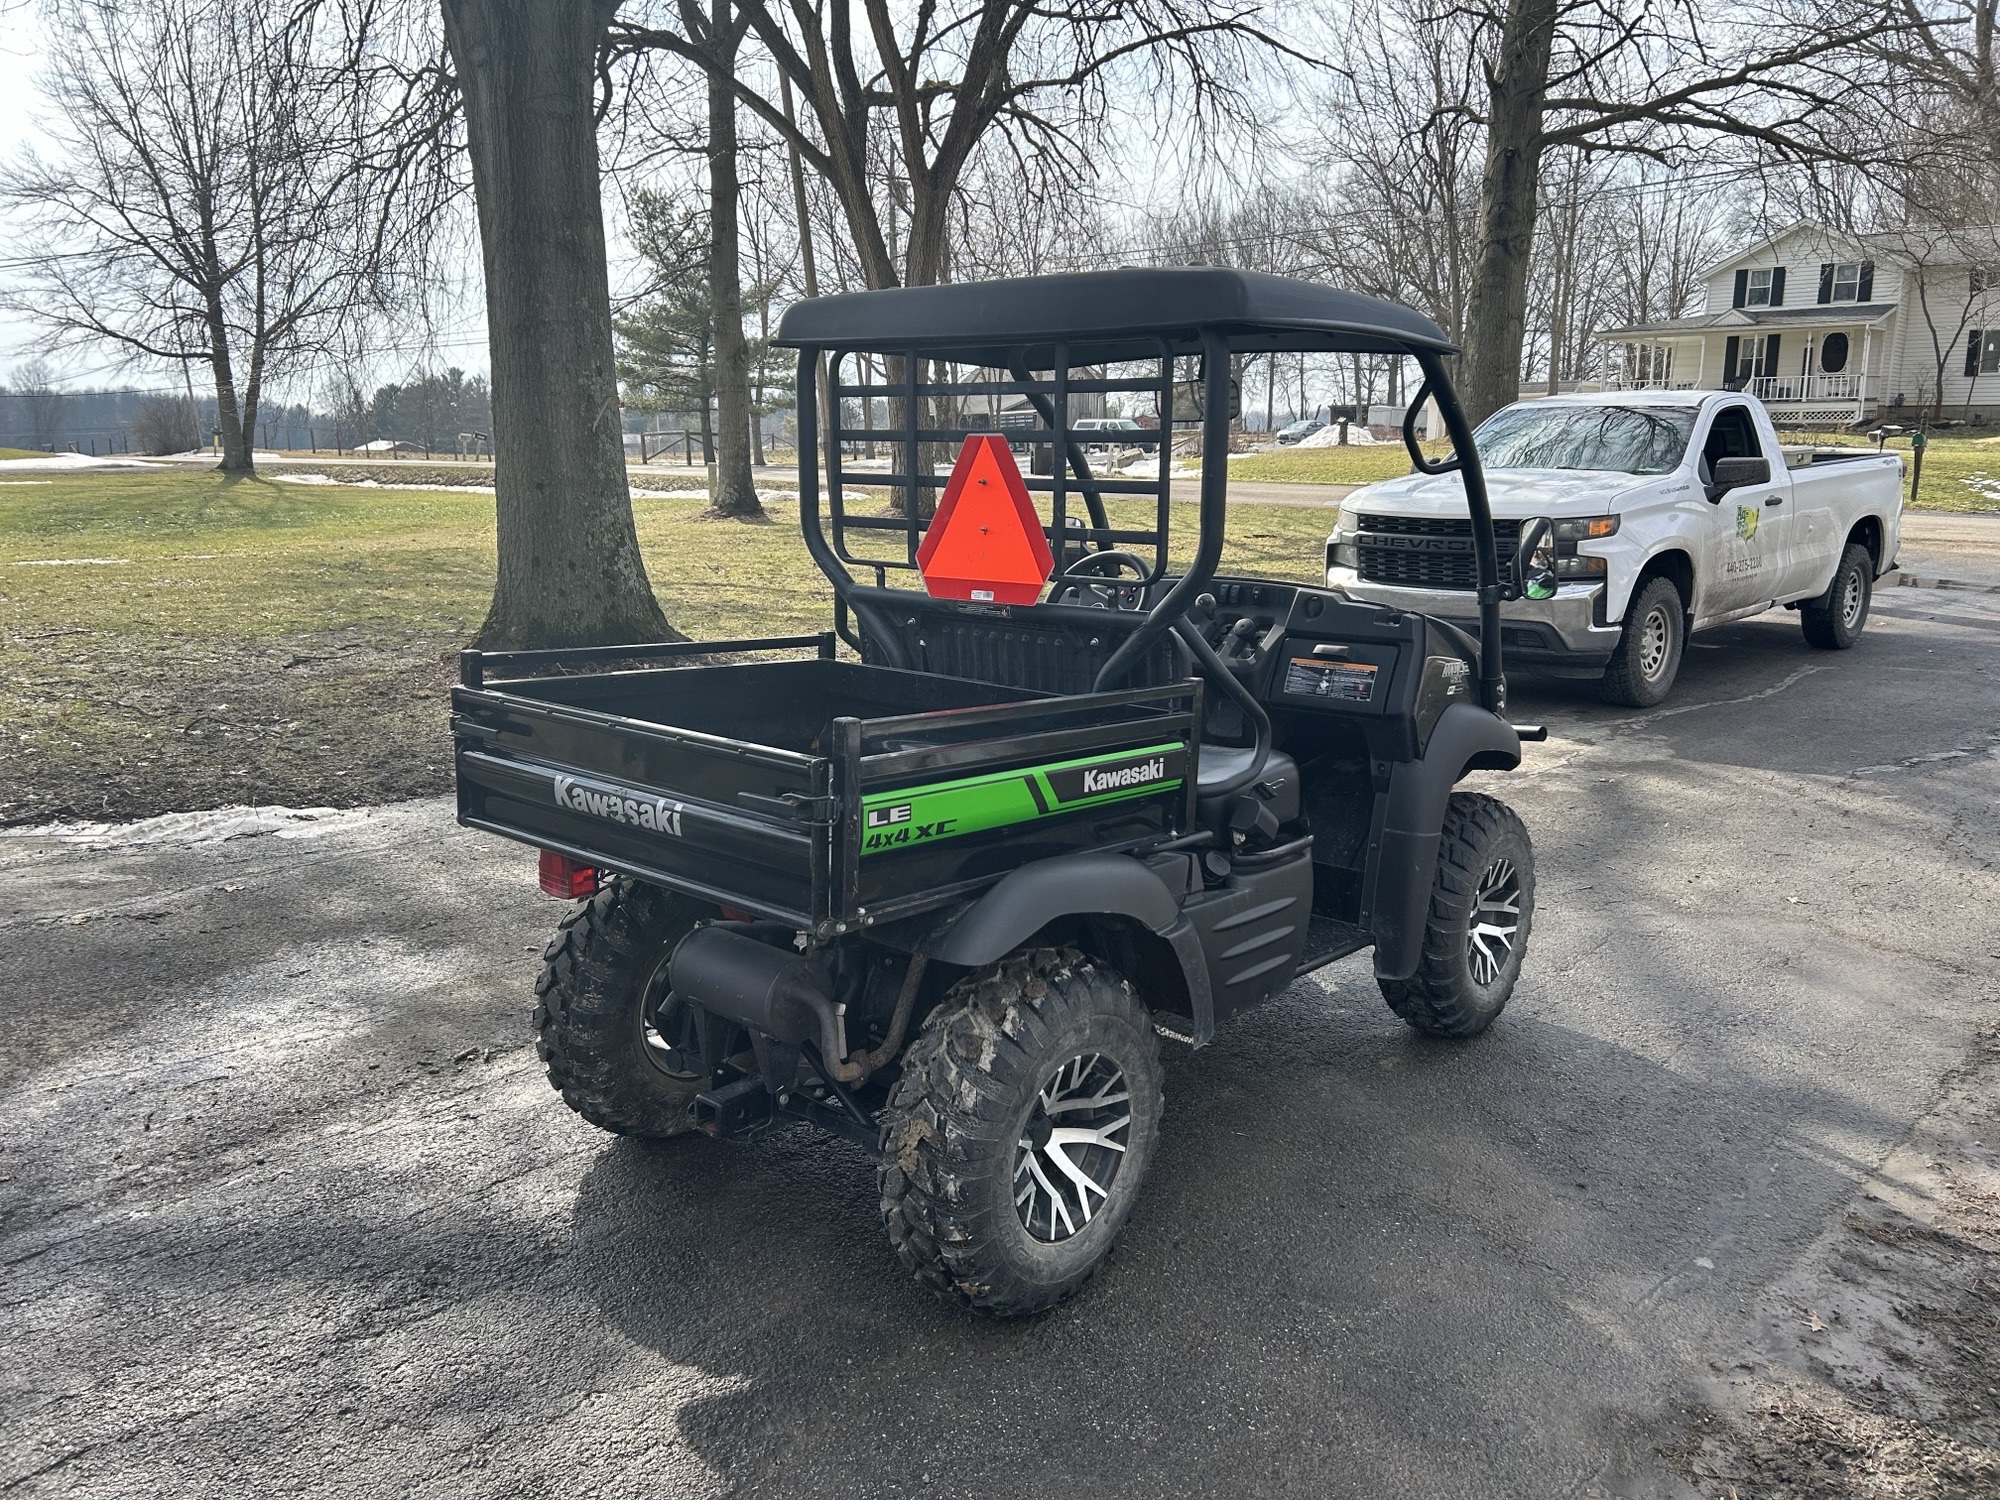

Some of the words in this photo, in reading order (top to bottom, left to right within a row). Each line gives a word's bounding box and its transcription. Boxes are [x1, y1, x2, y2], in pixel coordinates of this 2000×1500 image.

[1358, 535, 1519, 552] CHEVROE
[1083, 757, 1164, 793] Kawasaki
[554, 775, 685, 837] Kawasaki
[868, 805, 911, 827] LE
